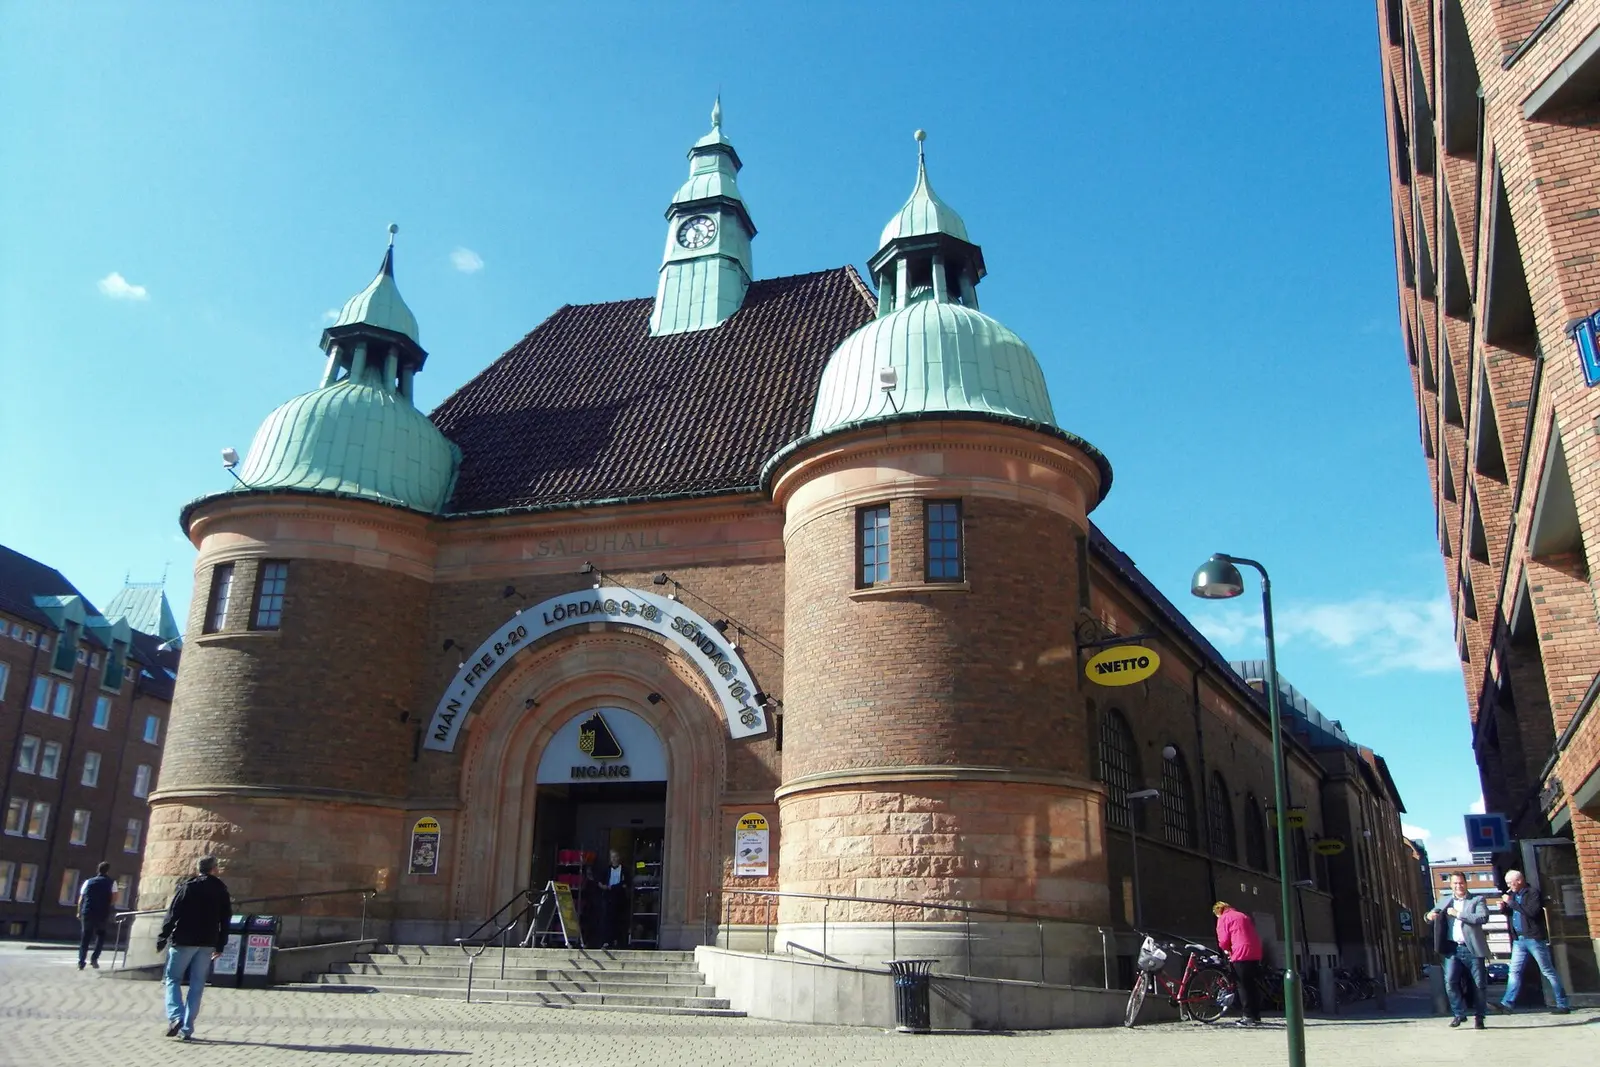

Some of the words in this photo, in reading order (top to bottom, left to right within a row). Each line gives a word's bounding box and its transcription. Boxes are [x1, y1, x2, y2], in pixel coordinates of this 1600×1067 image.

[537, 531, 669, 557] SALUHALL
[434, 698, 462, 742] MÅN
[464, 652, 496, 688] FRE
[494, 625, 527, 656] 8-20
[542, 598, 616, 626] LÖRDAG
[620, 600, 658, 621] 9-18
[670, 616, 732, 678] SÖNDAG
[727, 678, 756, 725] 10-18
[1098, 656, 1150, 674] NETTO
[570, 761, 630, 779] INGÅNG
[250, 936, 269, 944] CITY
